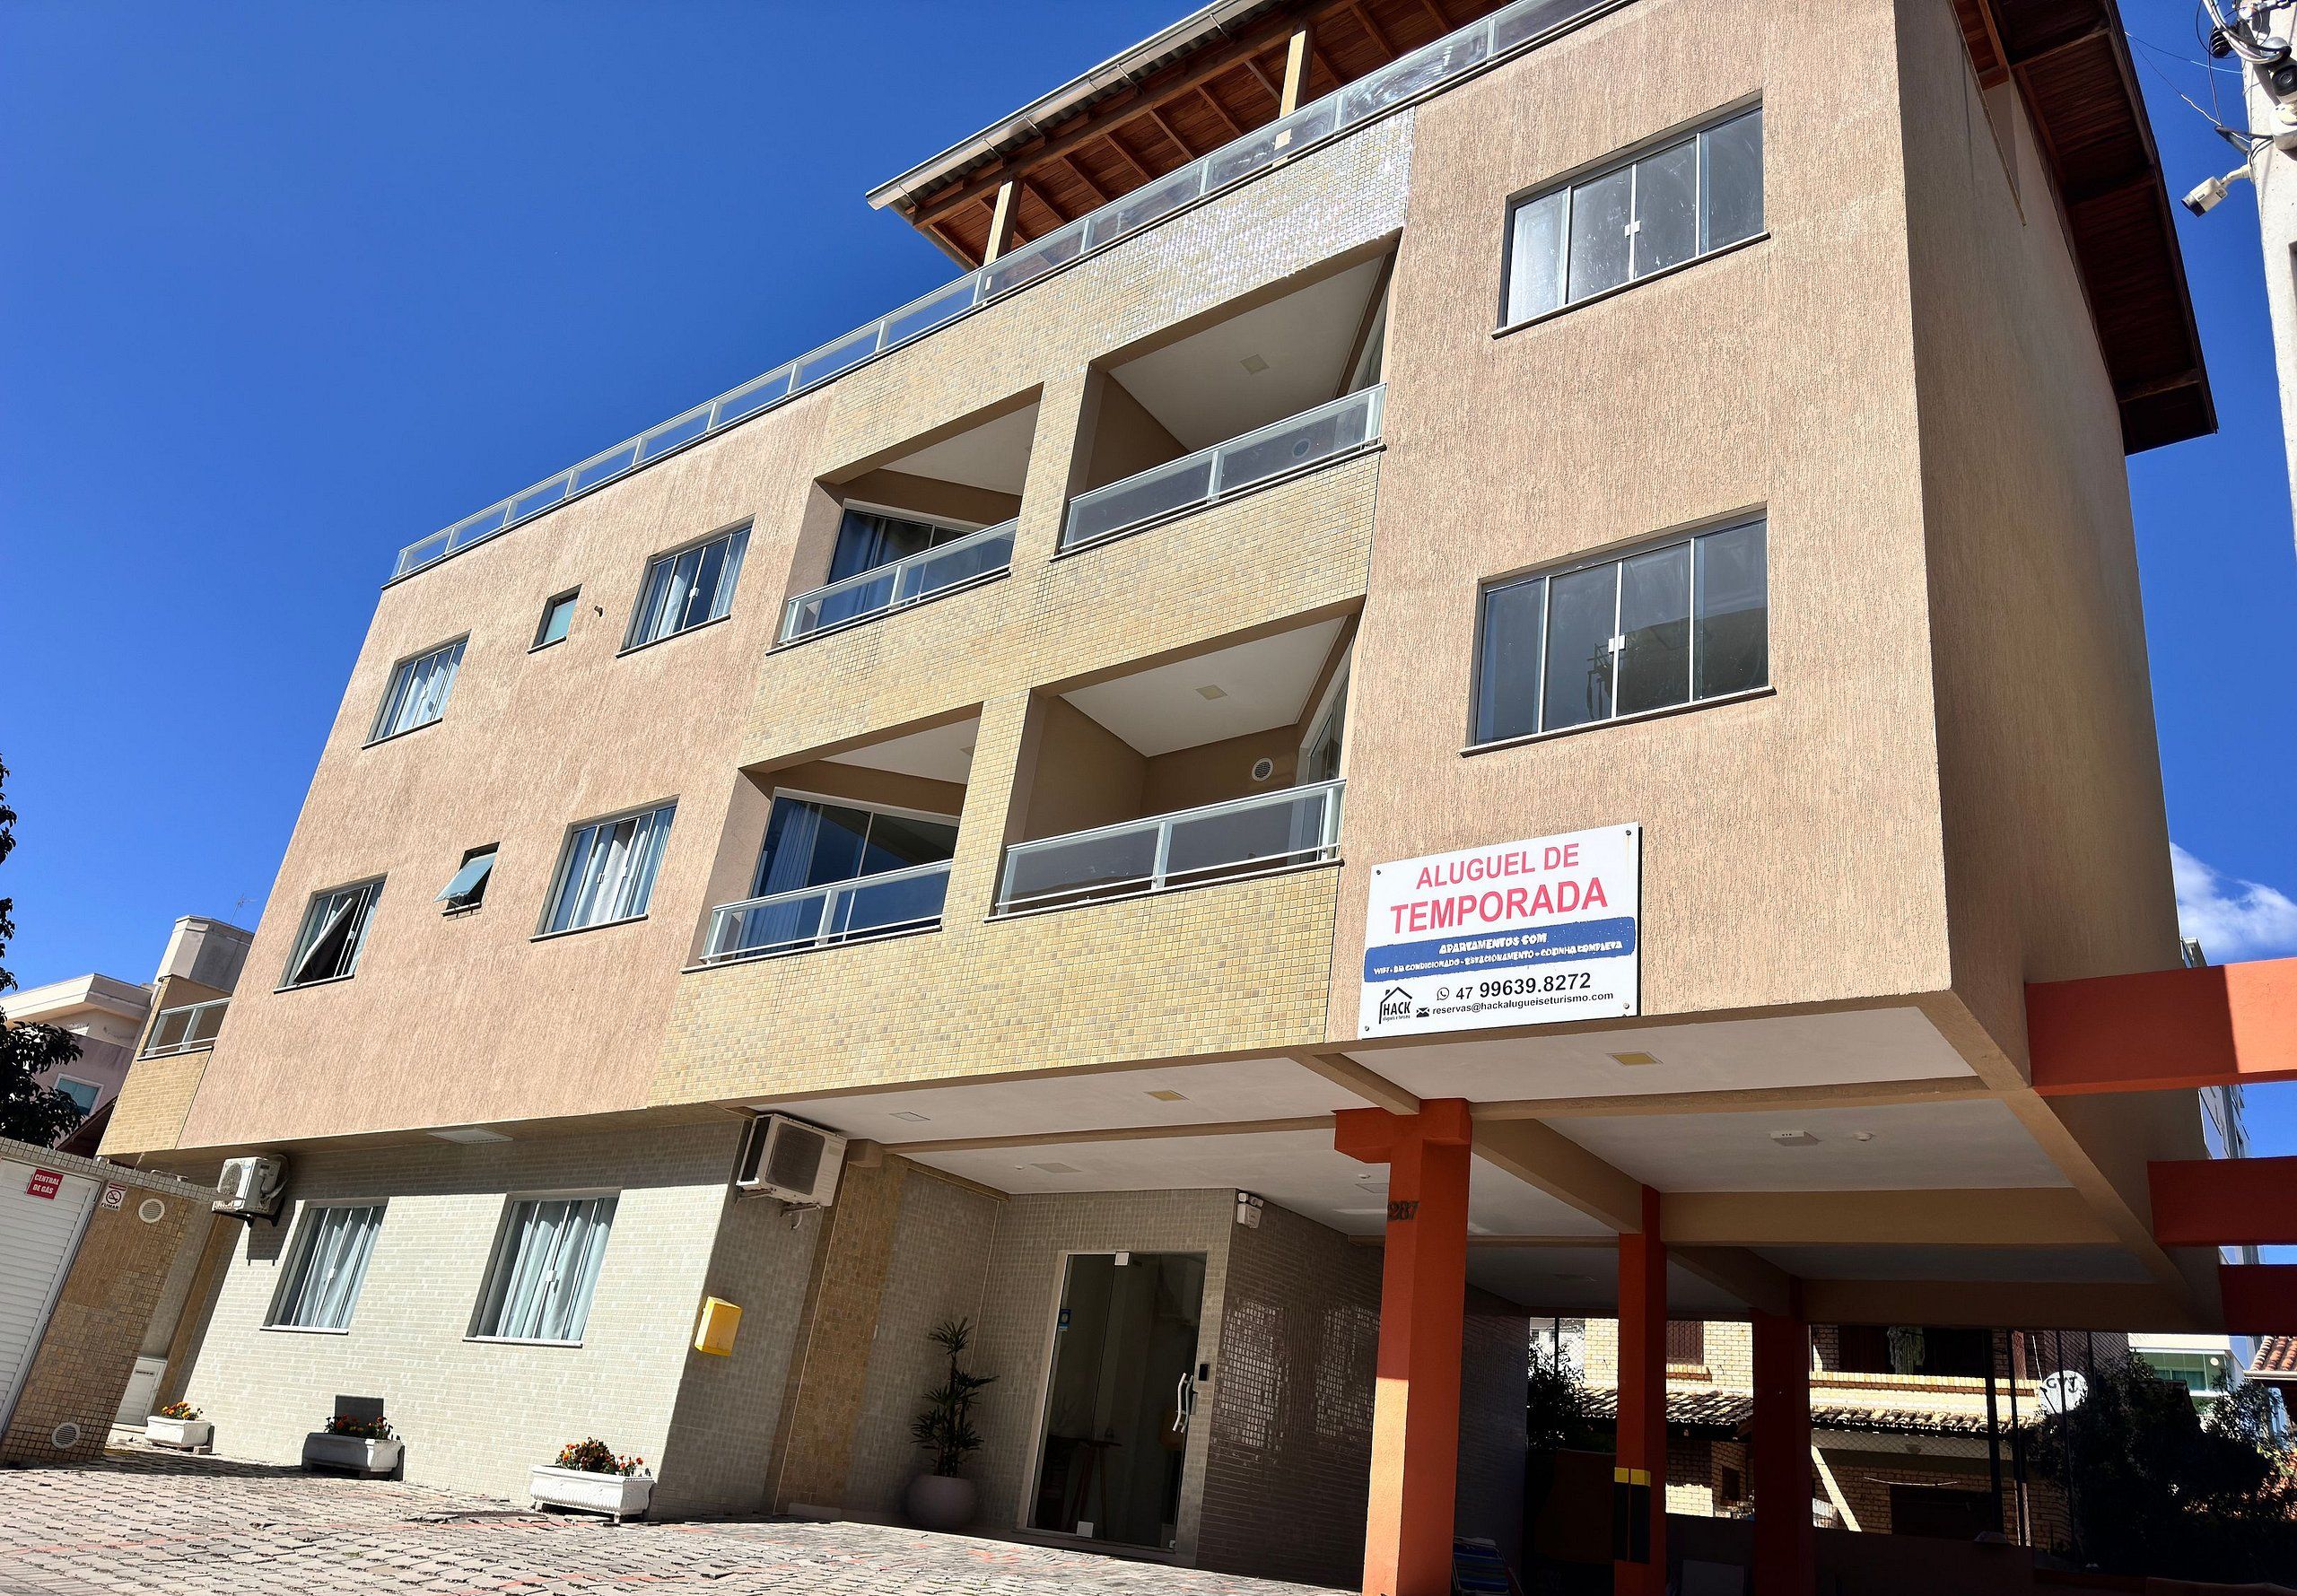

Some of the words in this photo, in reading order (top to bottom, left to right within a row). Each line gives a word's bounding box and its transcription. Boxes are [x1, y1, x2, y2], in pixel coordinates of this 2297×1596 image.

[1416, 851, 1535, 889] ALUGUEL
[1544, 843, 1579, 870] DE
[1391, 877, 1608, 934] TEMPORADA
[1521, 933, 1548, 946] COM
[1455, 987, 1473, 999] 47
[1480, 972, 1591, 999] 99639.8272
[1383, 1001, 1411, 1016] HACK
[1432, 992, 1614, 1015] reservas@hackalugueiseturismo.com
[34, 1174, 60, 1185] CENTRAL
